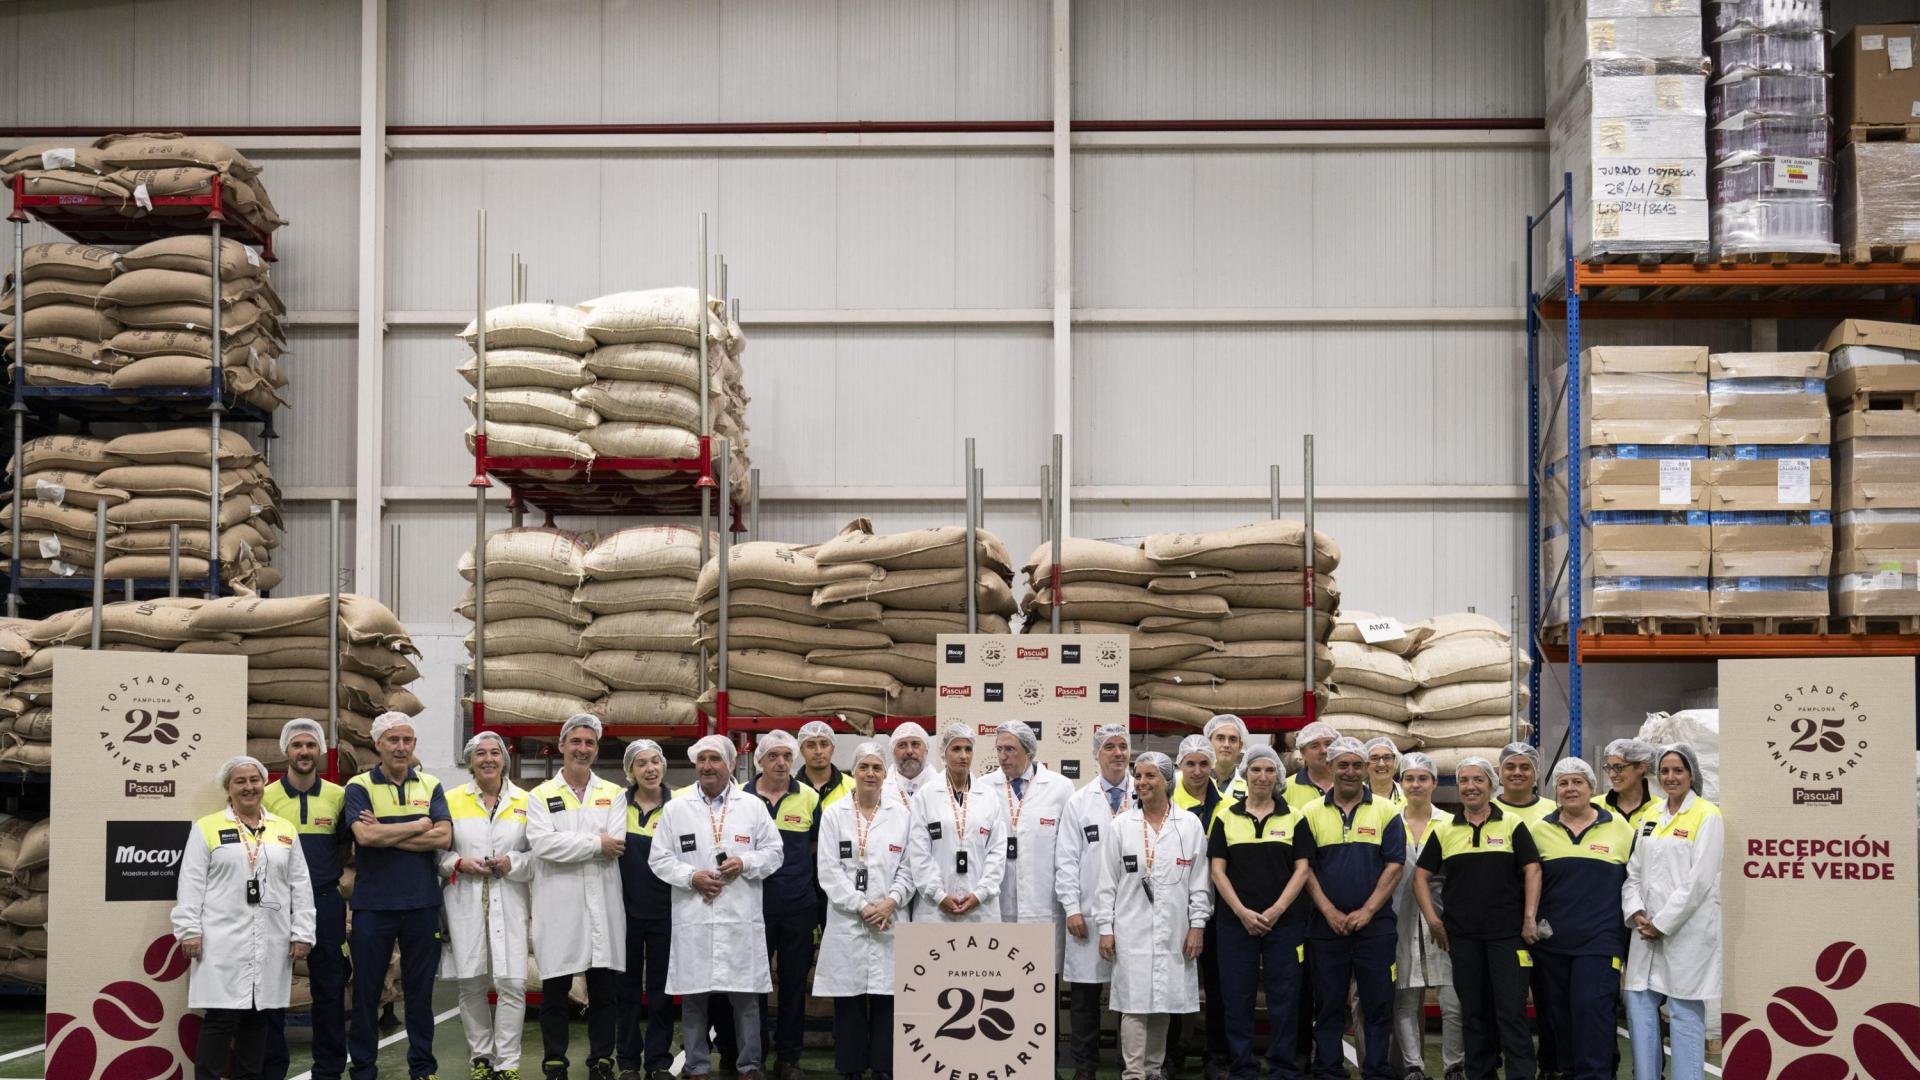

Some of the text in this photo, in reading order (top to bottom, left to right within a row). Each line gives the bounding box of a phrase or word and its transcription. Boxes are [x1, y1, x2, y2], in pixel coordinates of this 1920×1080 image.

[1598, 165, 1641, 176] JURADO
[1604, 180, 1675, 197] 28/01/25
[1369, 623, 1391, 631] AM2
[1019, 649, 1047, 657] Pascual
[101, 675, 201, 715] TOSTADERO
[942, 687, 970, 695] Pascual
[1057, 687, 1085, 695] Pascual
[1767, 684, 1867, 723] TOSTADERO
[123, 708, 180, 745] 25
[1789, 717, 1846, 753] 25
[100, 731, 202, 774] ANIVERSARIO
[1767, 740, 1868, 781] ANIVERSARIO
[129, 782, 172, 793] Pascual
[1796, 790, 1840, 801] Pascual
[115, 845, 182, 867] Mocay
[1747, 834, 1890, 858] RECEPCIÓN
[1743, 857, 1895, 880] CAFÉ VERDE
[903, 935, 1046, 994] TOSTADERO
[934, 987, 1016, 1042] 25
[902, 1022, 1047, 1080] ANIVERSARIO
